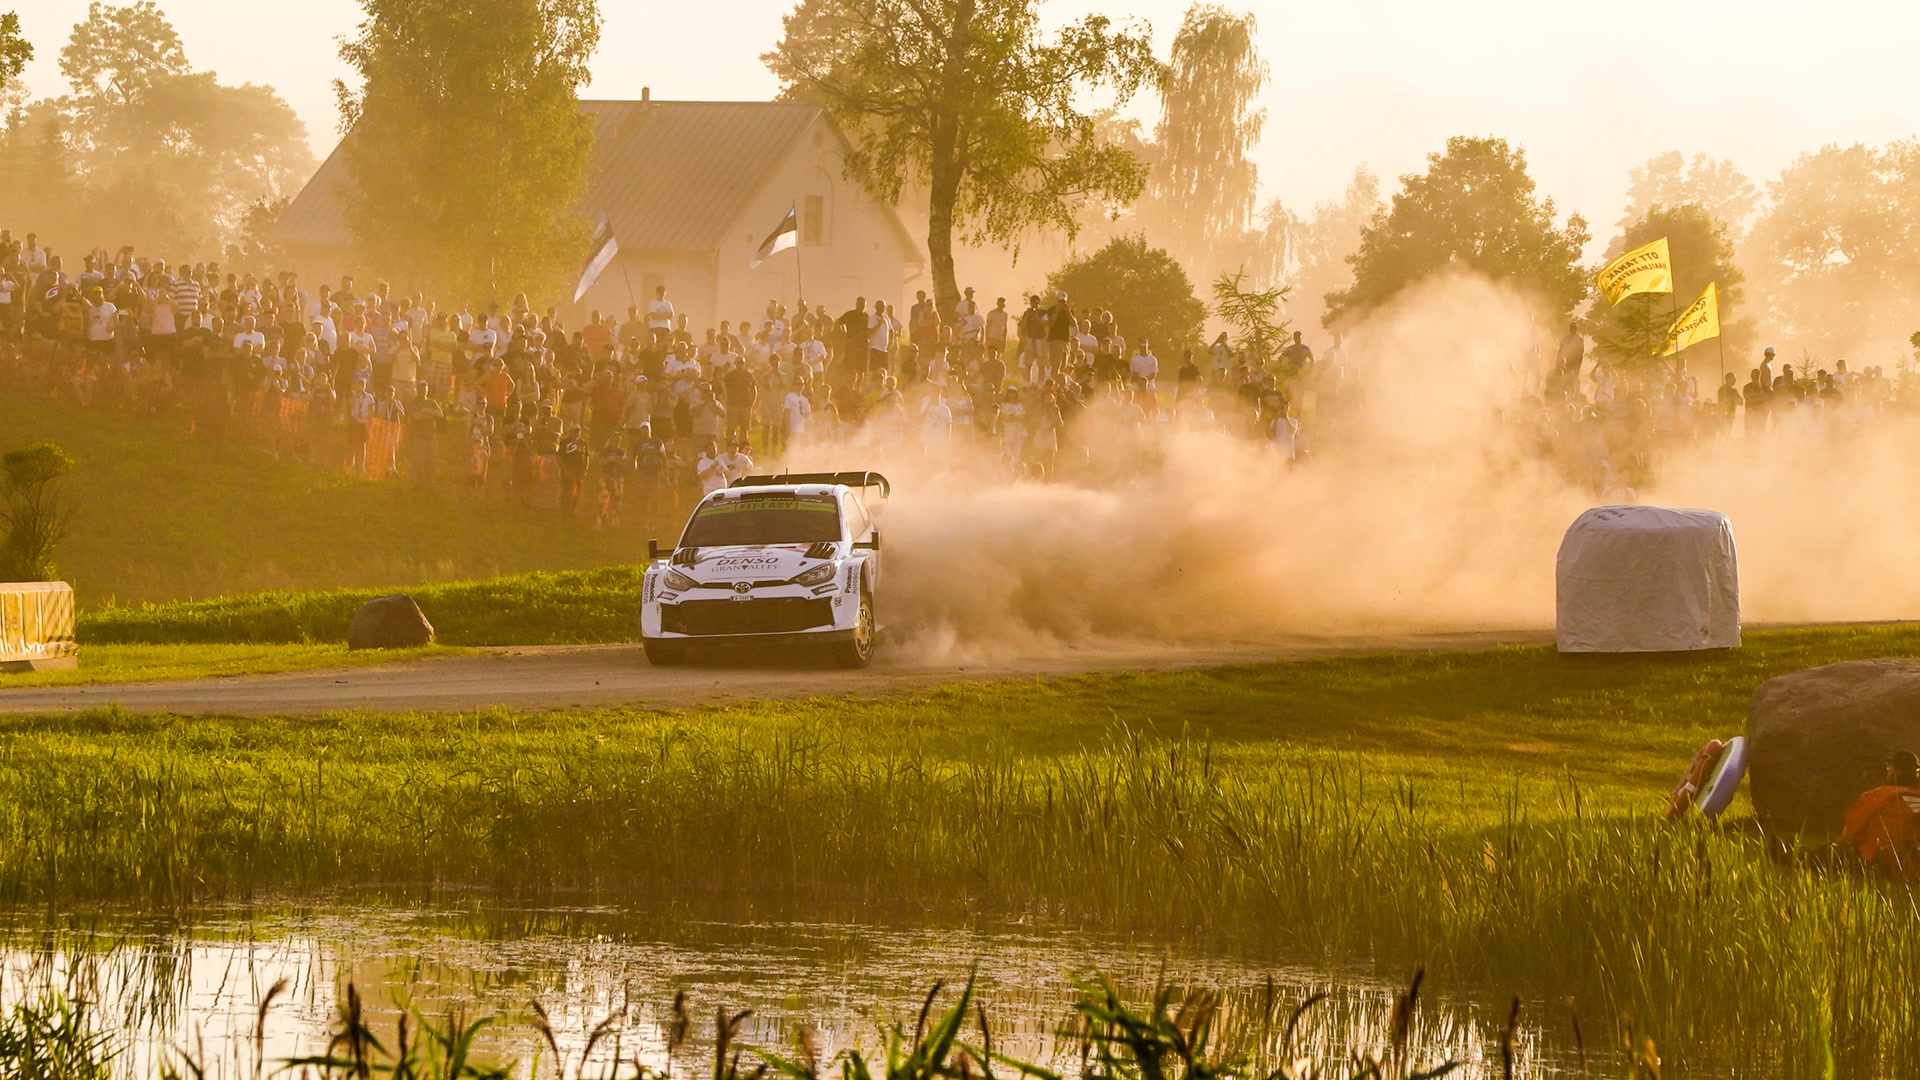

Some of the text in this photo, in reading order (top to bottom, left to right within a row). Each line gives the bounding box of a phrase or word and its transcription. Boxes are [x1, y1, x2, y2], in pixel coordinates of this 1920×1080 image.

[716, 557, 779, 566] DENSO
[649, 573, 658, 603] Panasonic
[845, 565, 853, 594] Panasonic
